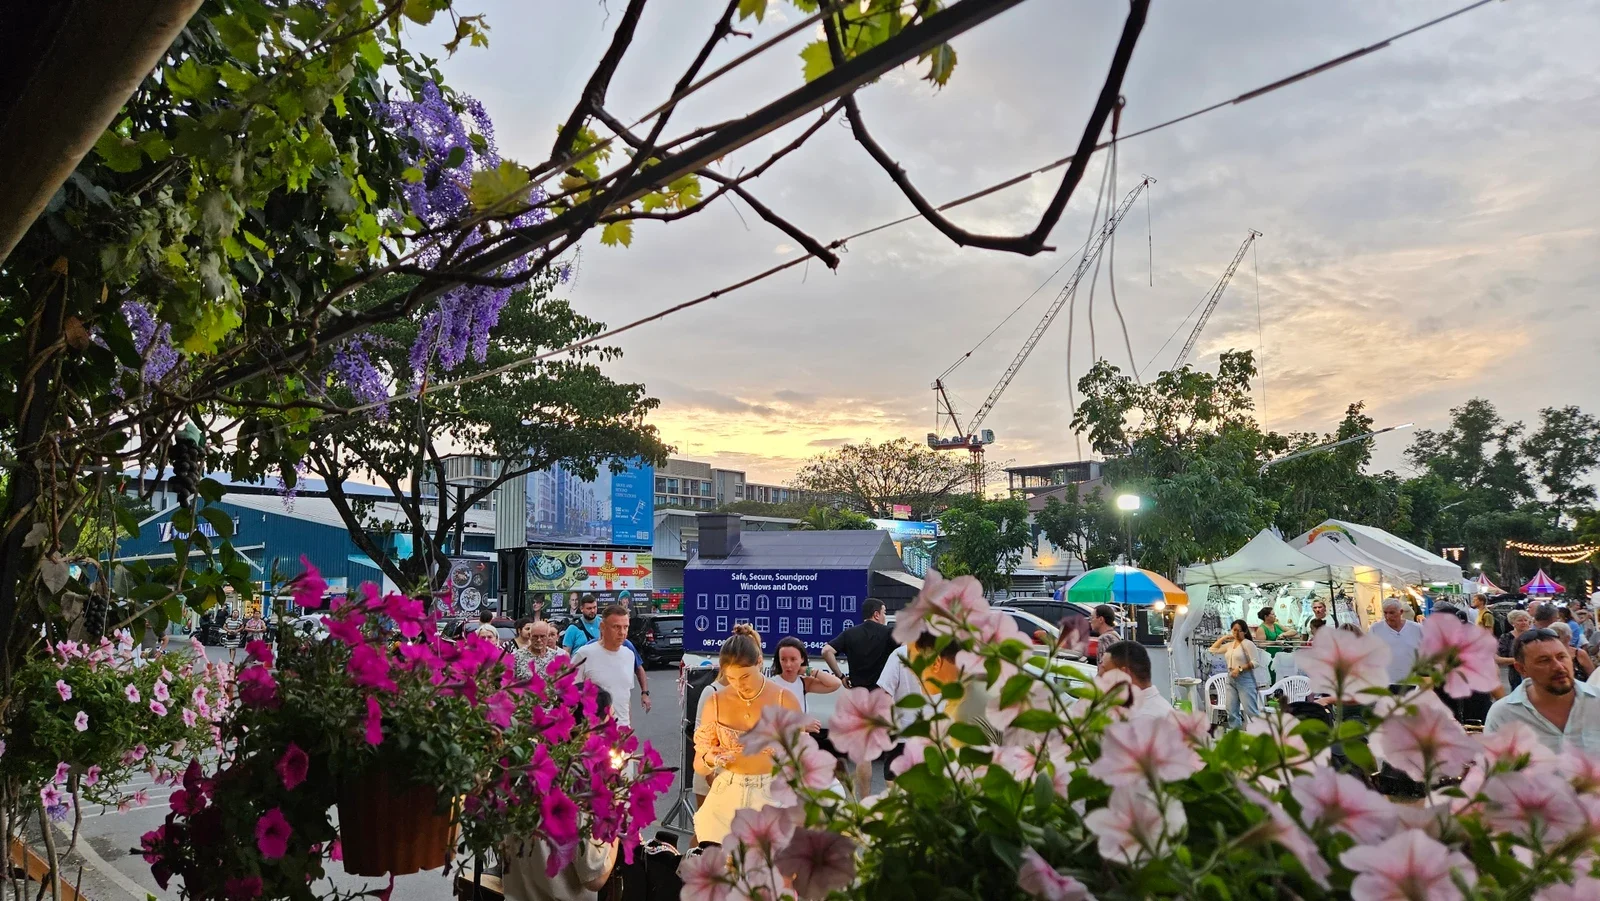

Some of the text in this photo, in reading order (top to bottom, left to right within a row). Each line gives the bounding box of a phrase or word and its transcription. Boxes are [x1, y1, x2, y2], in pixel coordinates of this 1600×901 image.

[731, 573, 818, 582] Safe, Secure, Soundproof
[772, 583, 786, 591] and
[787, 583, 809, 591] Doors
